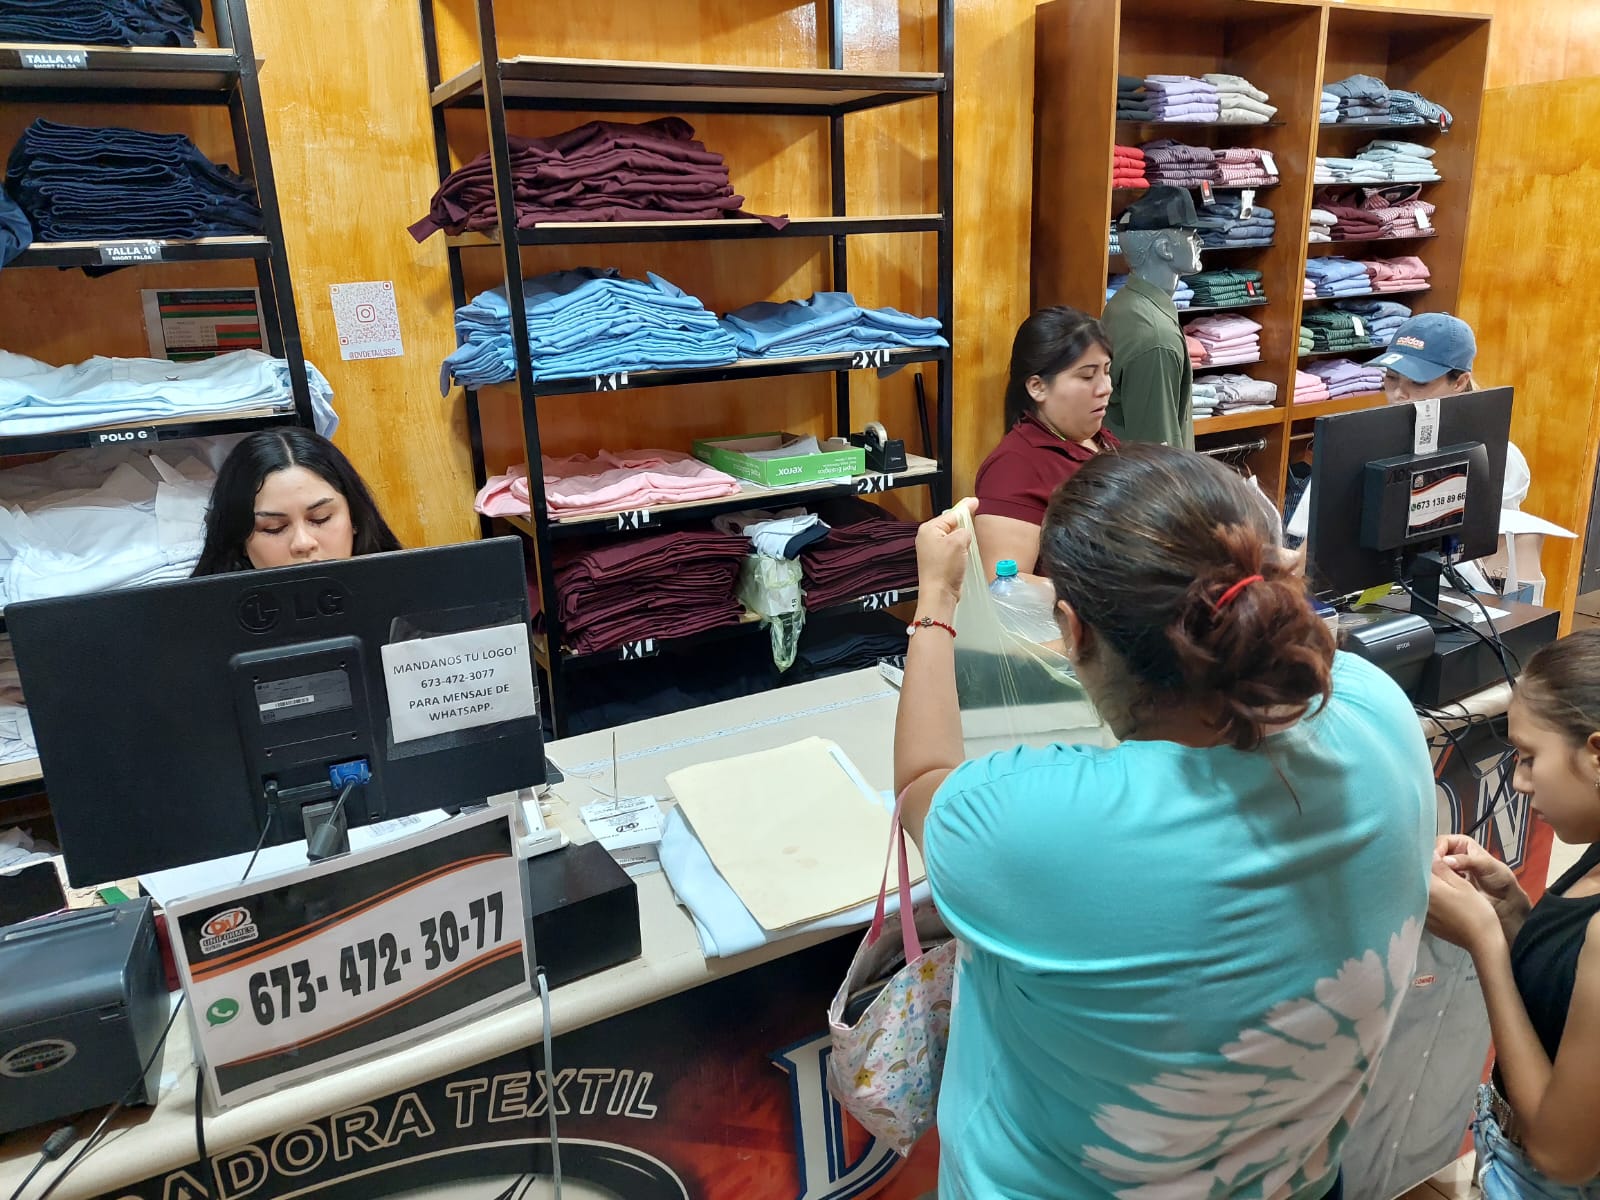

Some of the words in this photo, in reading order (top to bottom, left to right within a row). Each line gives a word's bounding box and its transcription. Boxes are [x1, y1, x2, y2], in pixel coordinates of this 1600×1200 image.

[26, 54, 64, 64] TALLA
[66, 54, 81, 64] 14
[105, 247, 141, 256] TALLA
[143, 246, 157, 255] 10
[1397, 336, 1425, 348] adidas
[852, 350, 890, 369] 2XL
[596, 372, 629, 392] XL
[99, 432, 135, 443] POLO
[137, 430, 148, 439] G
[780, 466, 803, 477] xerox
[858, 475, 894, 495] 2XL
[1416, 499, 1431, 510] 673
[1432, 496, 1445, 507] 138
[1446, 494, 1456, 504] 89
[1457, 491, 1467, 502] 66
[618, 510, 650, 530] XL
[863, 590, 899, 610] 2XL
[622, 638, 656, 660] XL
[393, 655, 462, 675] MANDANOS
[464, 652, 479, 662] TU
[482, 646, 518, 660] LOGO!
[421, 668, 495, 689] 673-472-3077
[409, 696, 440, 710] PARA
[443, 687, 493, 704] MENSAJE
[495, 683, 510, 694] DE
[429, 702, 495, 721] WHATSAPP.
[419, 890, 504, 971] 30-77
[446, 1068, 660, 1129] TEXTIL
